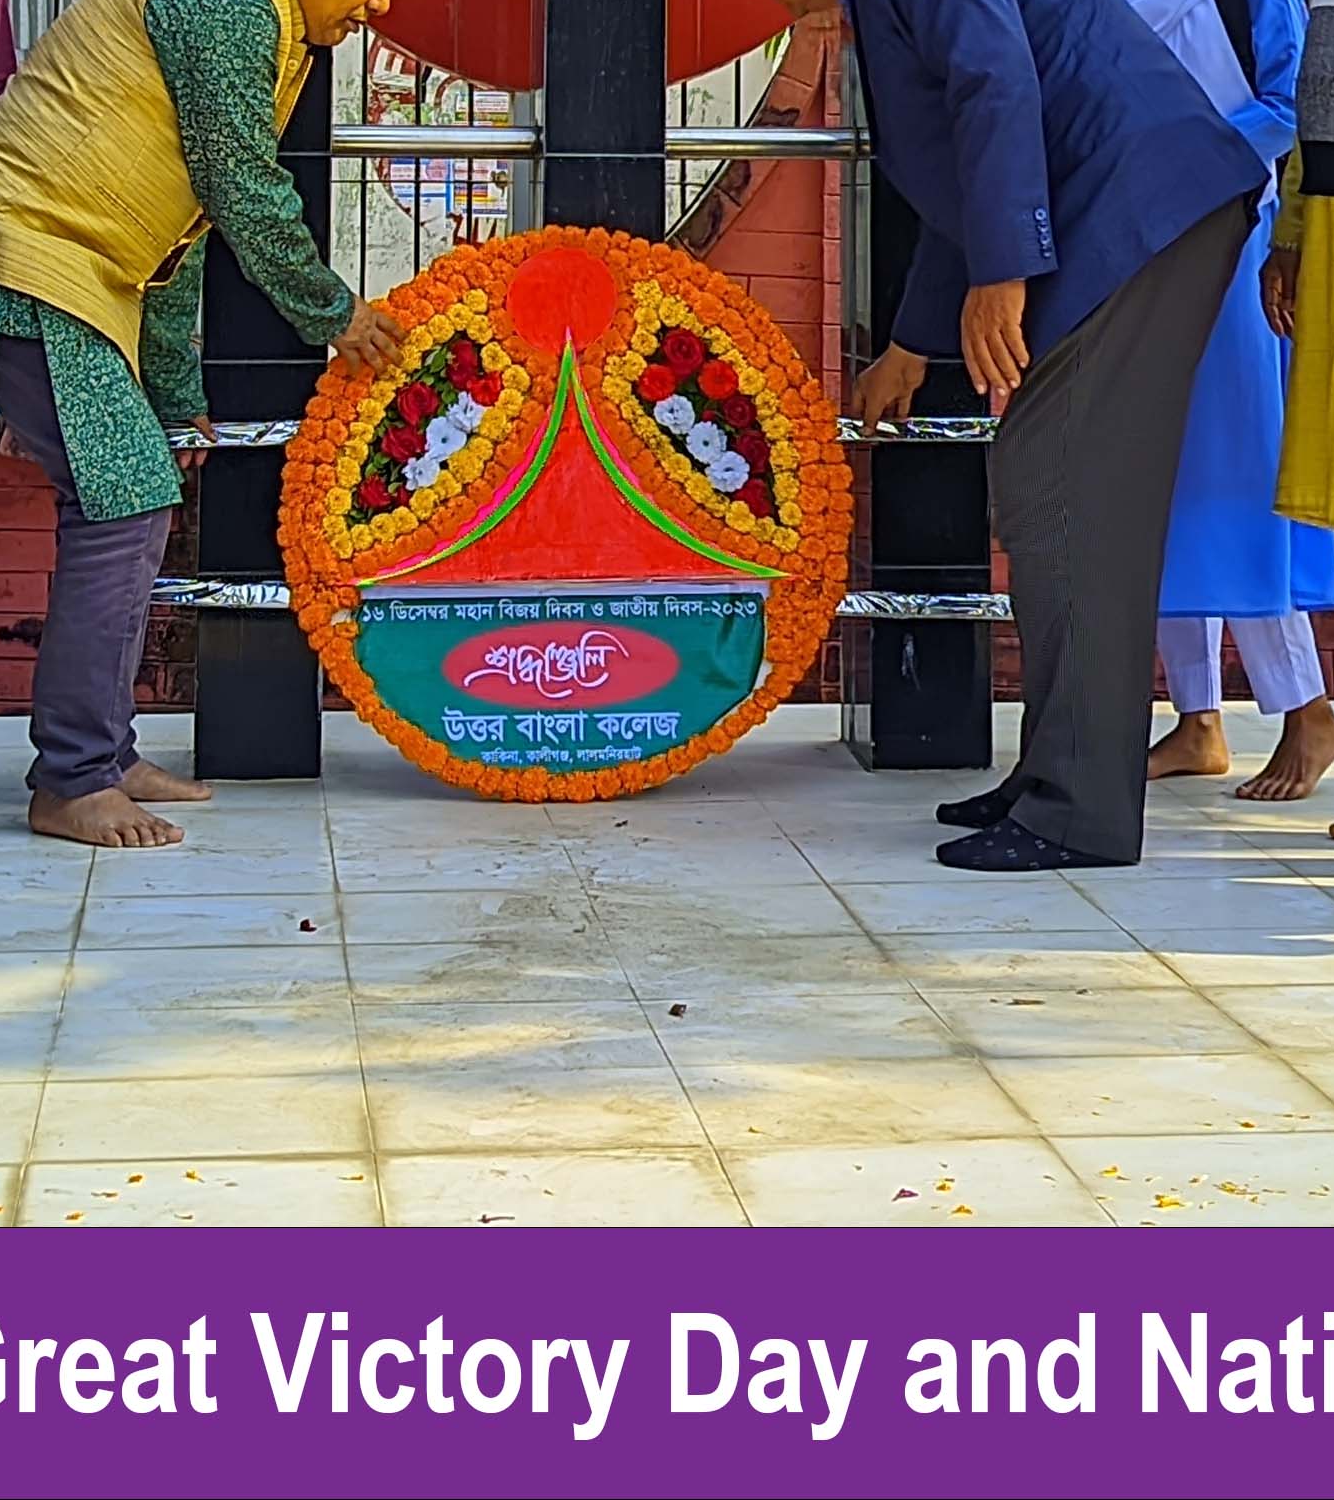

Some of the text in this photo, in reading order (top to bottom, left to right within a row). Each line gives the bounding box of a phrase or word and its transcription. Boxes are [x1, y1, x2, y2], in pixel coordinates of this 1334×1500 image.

[362, 596, 758, 622] ১৬ ডিসেম্বর মহান বিজয় দিবস ও জাতীয় দিবস-২০২৩
[441, 706, 682, 745] উত্তর বাংলা কলেজ
